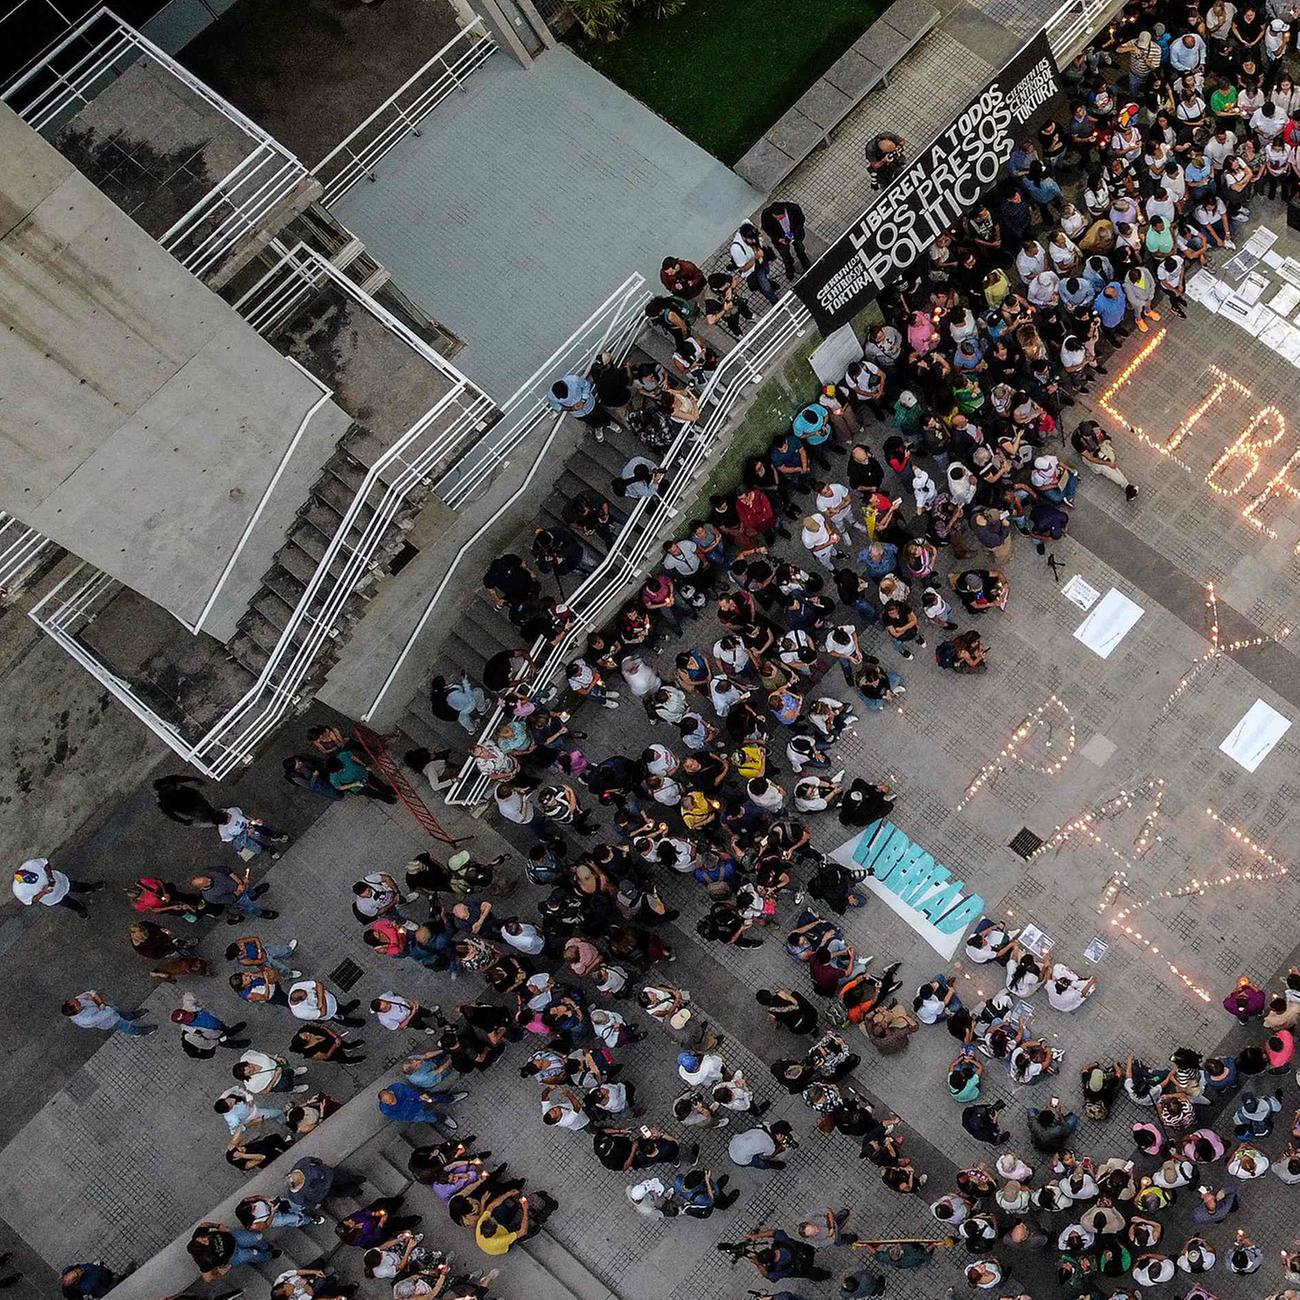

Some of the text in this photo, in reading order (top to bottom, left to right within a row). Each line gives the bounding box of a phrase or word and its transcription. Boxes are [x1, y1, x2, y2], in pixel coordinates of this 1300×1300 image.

[1010, 66, 1054, 112] CENTROS DE
[1012, 81, 1058, 125] TORTURA
[849, 83, 1003, 250] LIBEREN A TODOS
[859, 102, 1012, 269] LOS PRESOS
[825, 271, 873, 315] TORTURA
[1162, 580, 1294, 711] Y
[852, 819, 985, 934] LIBERTAD
[957, 694, 1290, 1002] PAZ
